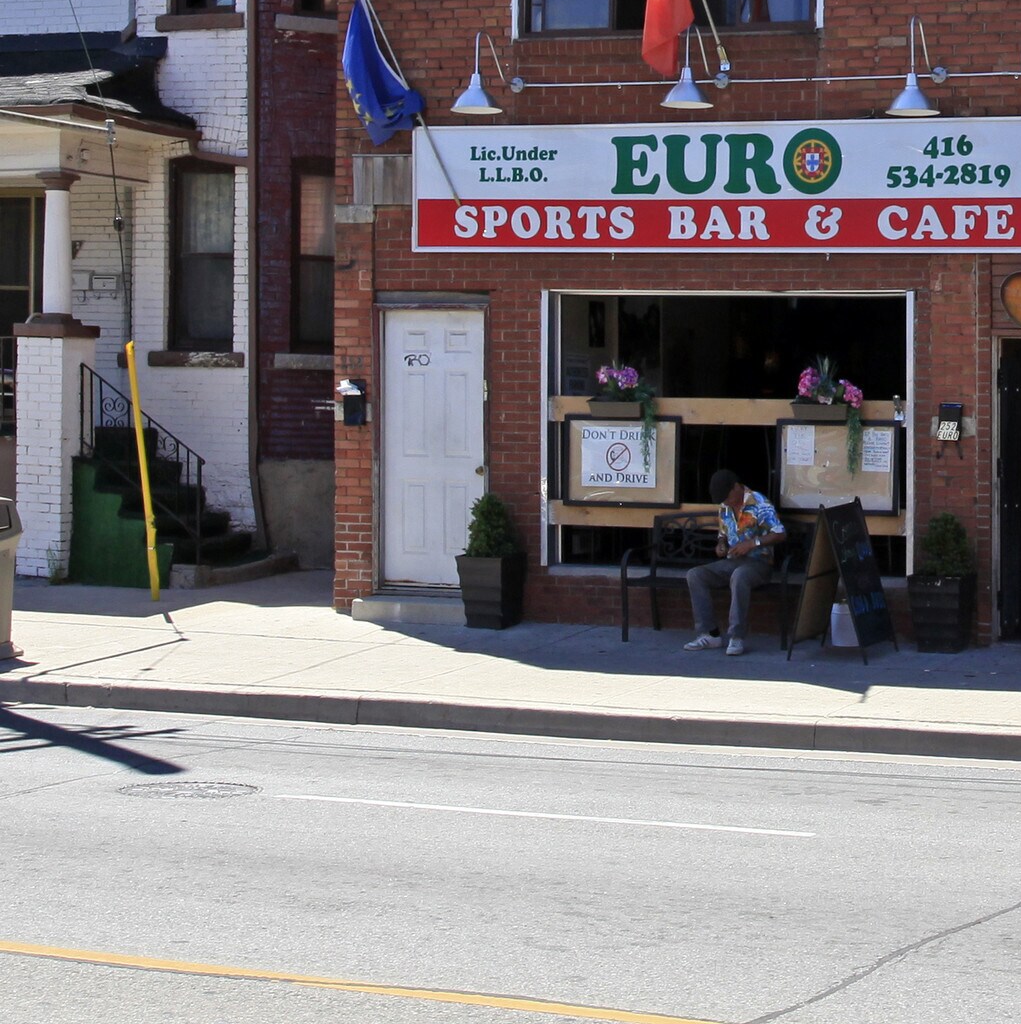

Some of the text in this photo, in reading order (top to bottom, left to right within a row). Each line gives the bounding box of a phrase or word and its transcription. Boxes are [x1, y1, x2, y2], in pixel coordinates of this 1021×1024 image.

[470, 145, 558, 161] Lic.Under
[923, 134, 974, 159] 416
[611, 128, 843, 195] EURO
[479, 167, 548, 182] L.L.B.O.
[886, 163, 1011, 188] 534-2819
[453, 204, 1016, 240] SPORTS BAR & CAFE
[940, 422, 958, 431] 252
[582, 429, 617, 440] DON'T
[937, 430, 960, 441] EURO
[589, 473, 649, 484] AND DRIVE
